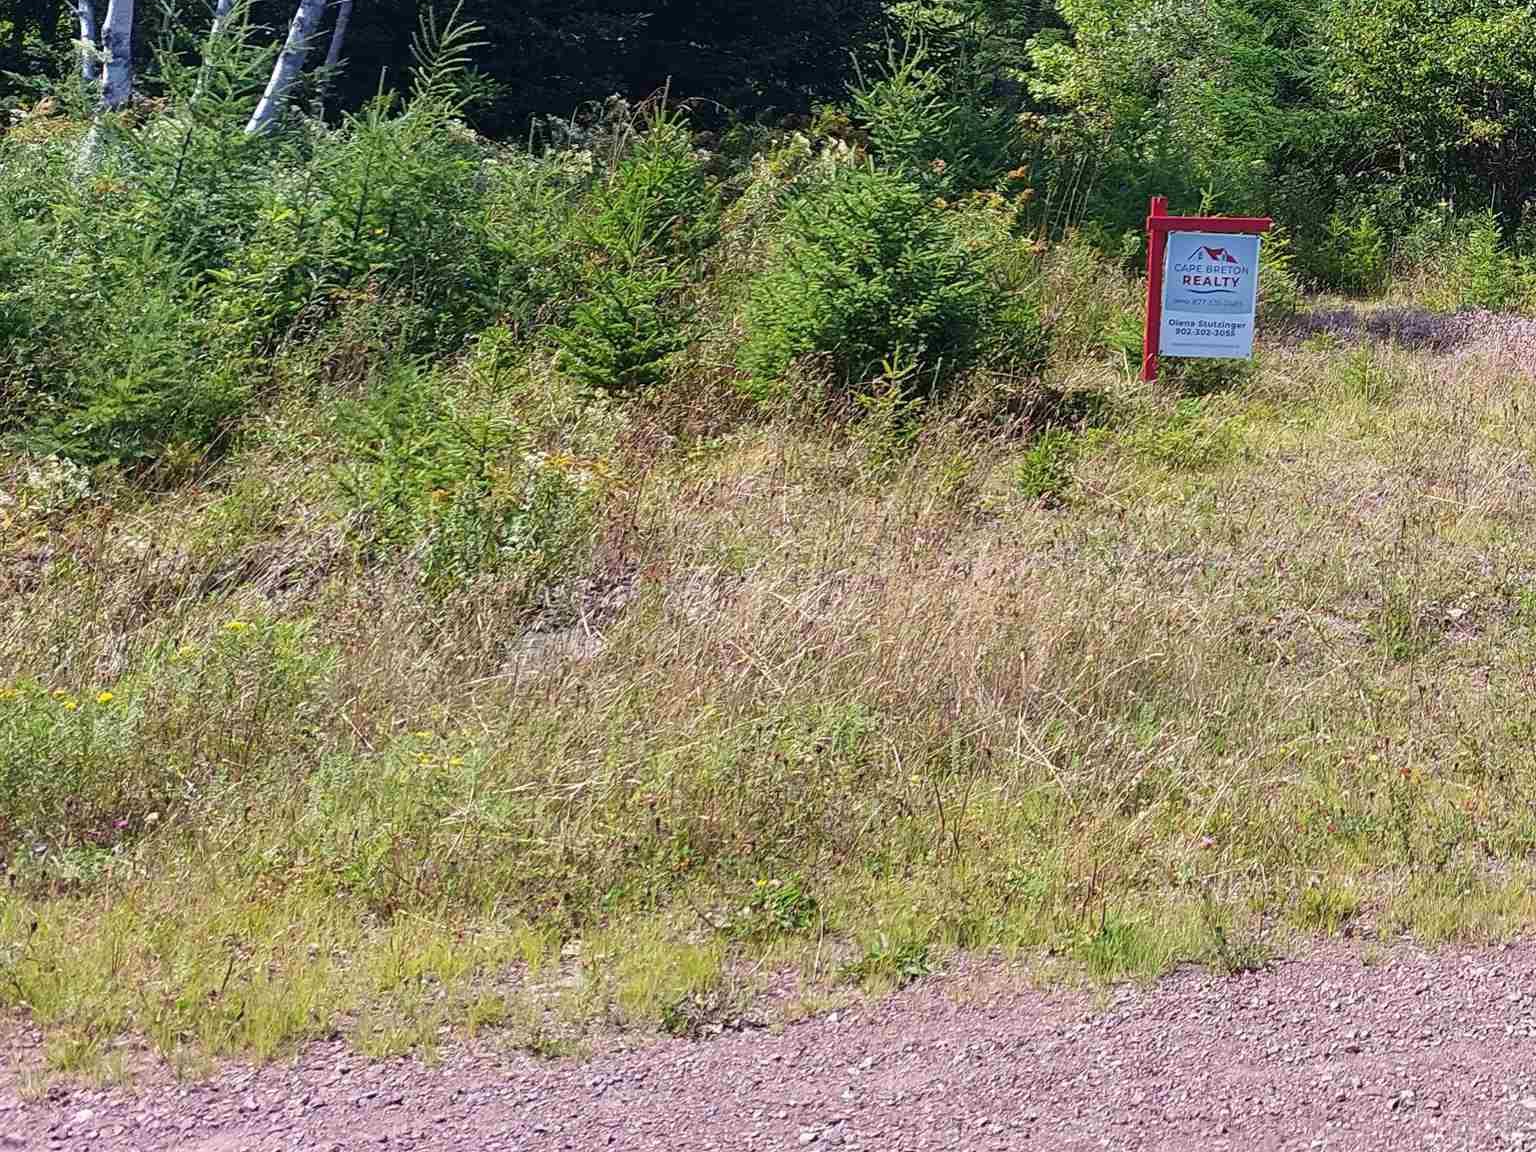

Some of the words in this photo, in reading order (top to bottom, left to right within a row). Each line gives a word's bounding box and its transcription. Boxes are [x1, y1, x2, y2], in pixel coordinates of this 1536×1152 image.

[1174, 263, 1204, 273] CAPE
[1206, 264, 1249, 275] BRETON
[1183, 275, 1240, 288] REALTY
